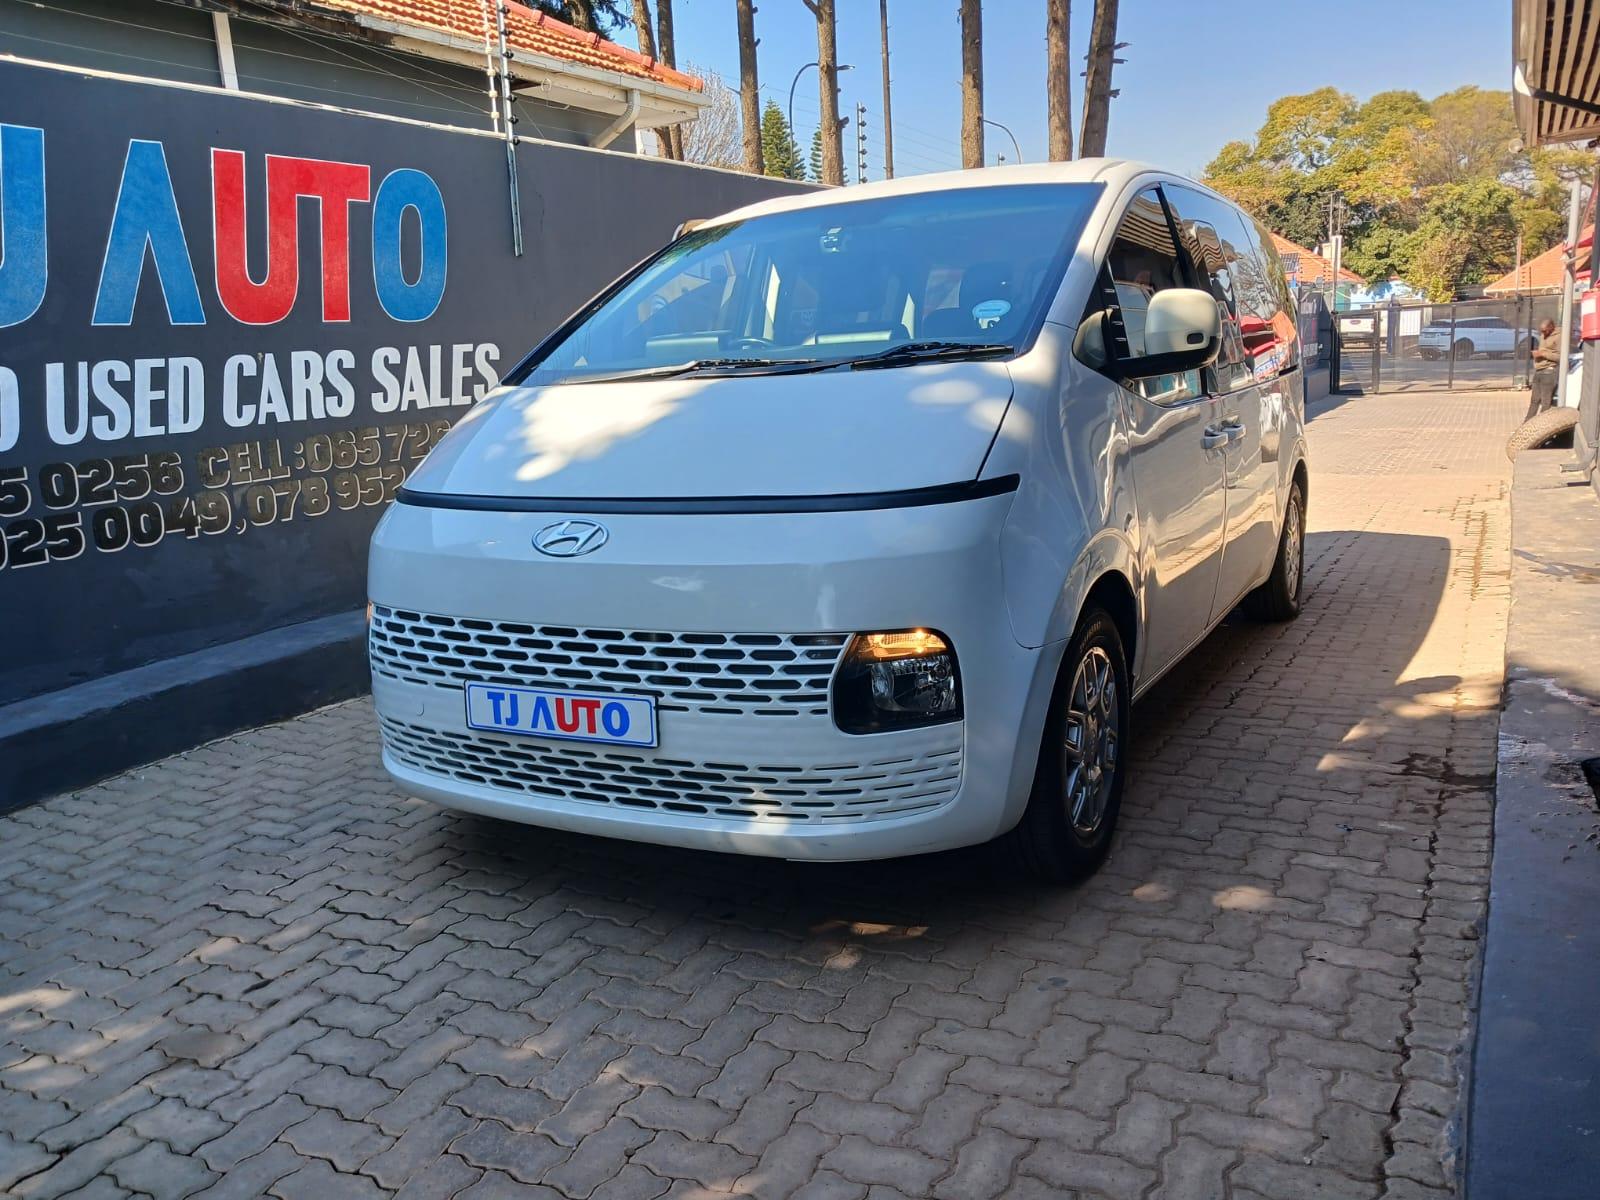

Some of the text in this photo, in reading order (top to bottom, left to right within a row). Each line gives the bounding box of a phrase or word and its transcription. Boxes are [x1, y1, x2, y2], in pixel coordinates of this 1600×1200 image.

[91, 138, 447, 325] AUTO
[46, 357, 205, 445] USED
[222, 350, 356, 427] CARS
[371, 343, 500, 413] SALES
[39, 451, 184, 510] 0256
[0, 511, 86, 571] 25
[487, 691, 630, 737] TJ AUTO
